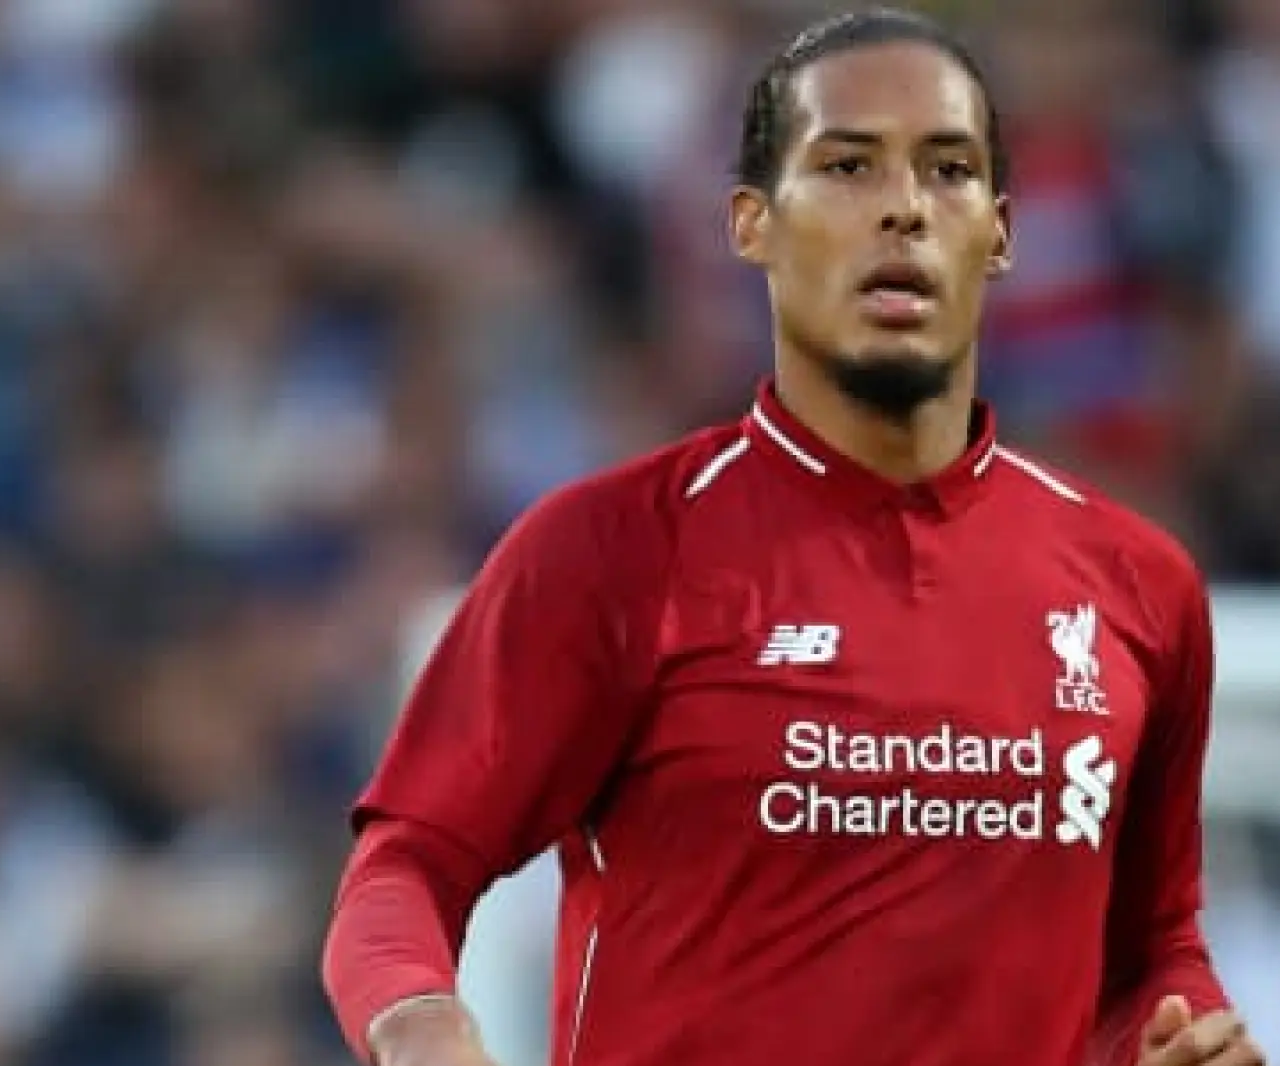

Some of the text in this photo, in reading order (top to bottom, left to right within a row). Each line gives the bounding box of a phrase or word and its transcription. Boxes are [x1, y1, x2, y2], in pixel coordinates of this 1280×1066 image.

[759, 623, 841, 667] NB
[785, 720, 1044, 775] Standard
[760, 782, 1044, 839] Chartered
